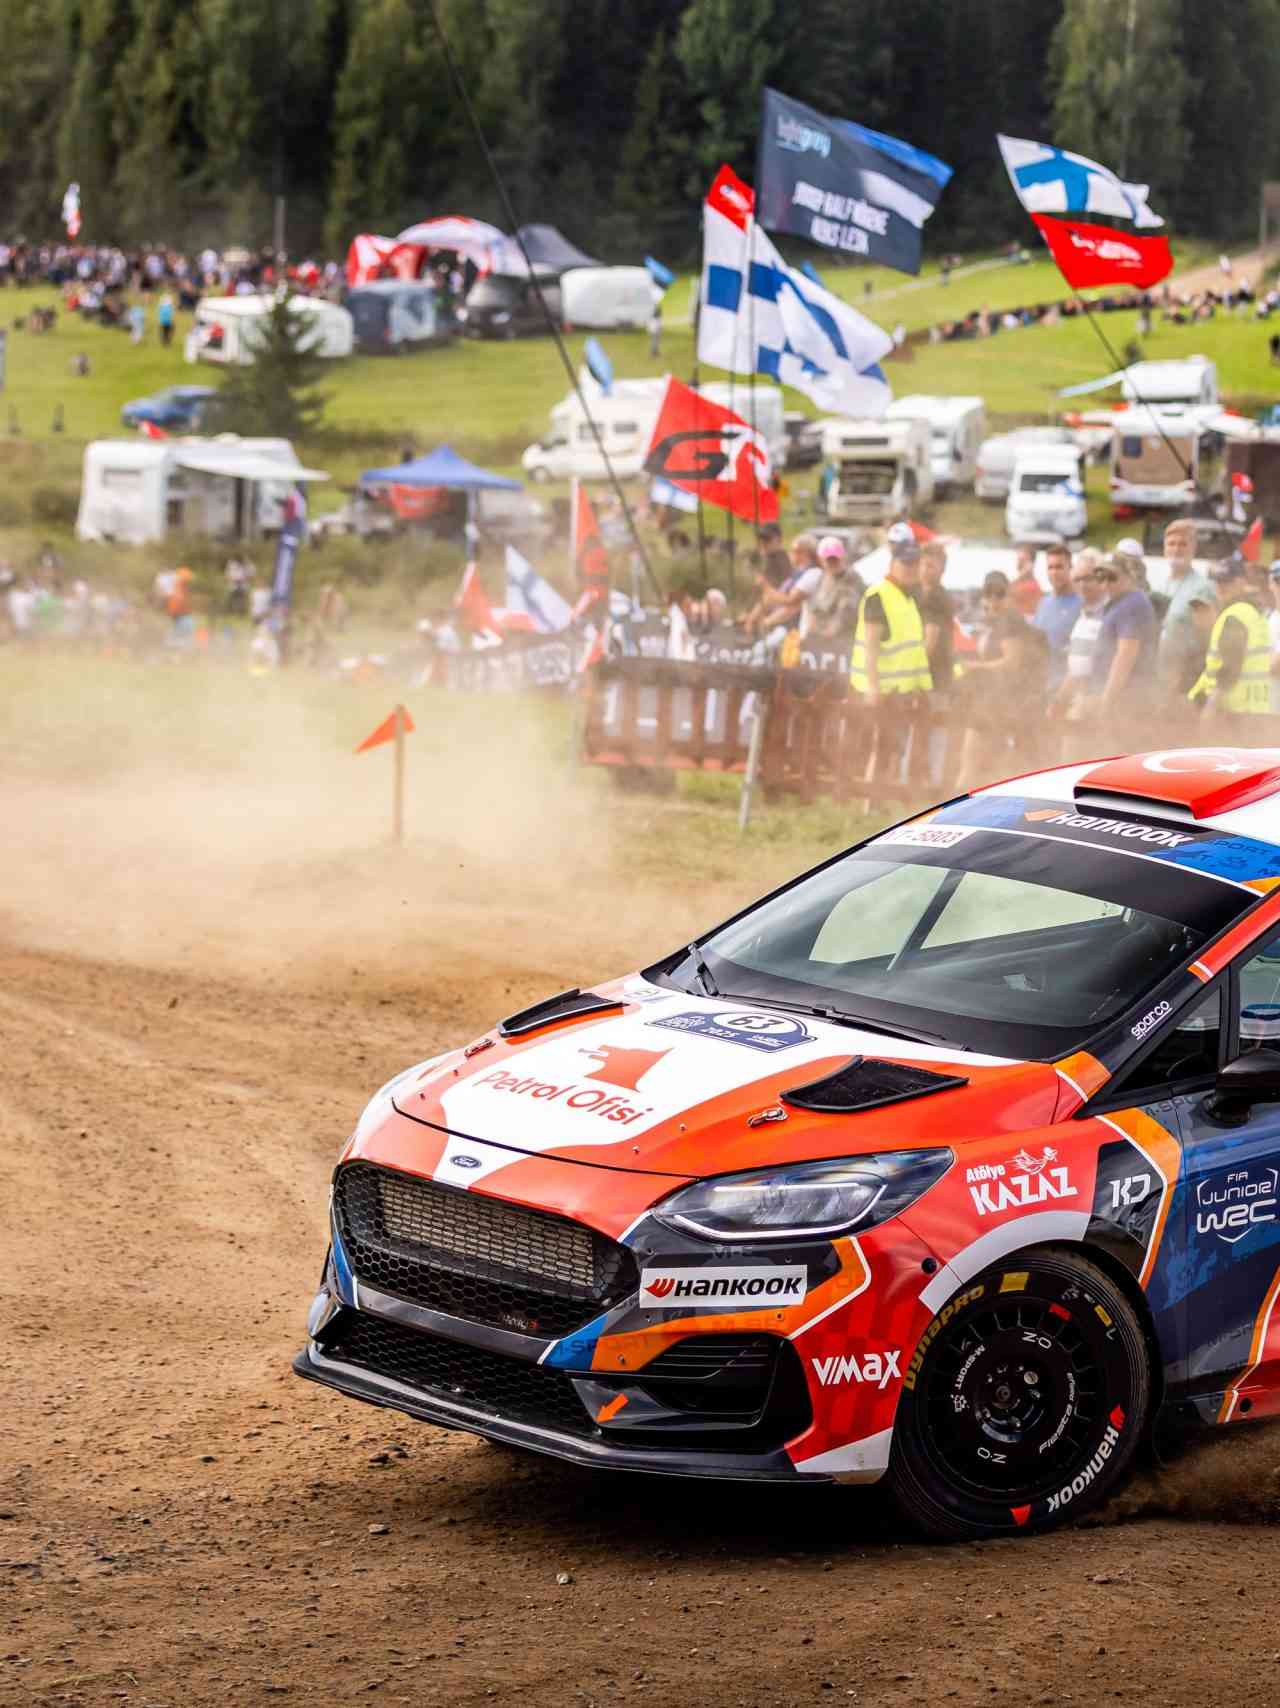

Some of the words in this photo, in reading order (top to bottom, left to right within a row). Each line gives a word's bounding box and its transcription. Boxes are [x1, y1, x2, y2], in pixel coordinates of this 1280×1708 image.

[728, 1015, 785, 1030] 63
[1131, 1000, 1172, 1039] sparco
[472, 1069, 577, 1101] Petrol
[566, 1088, 654, 1126] Ofisi
[969, 1167, 1079, 1216] KAZAZ
[1201, 1181, 1272, 1206] JUNIOR
[1227, 1171, 1249, 1184] FIA
[1196, 1198, 1277, 1234] WRC
